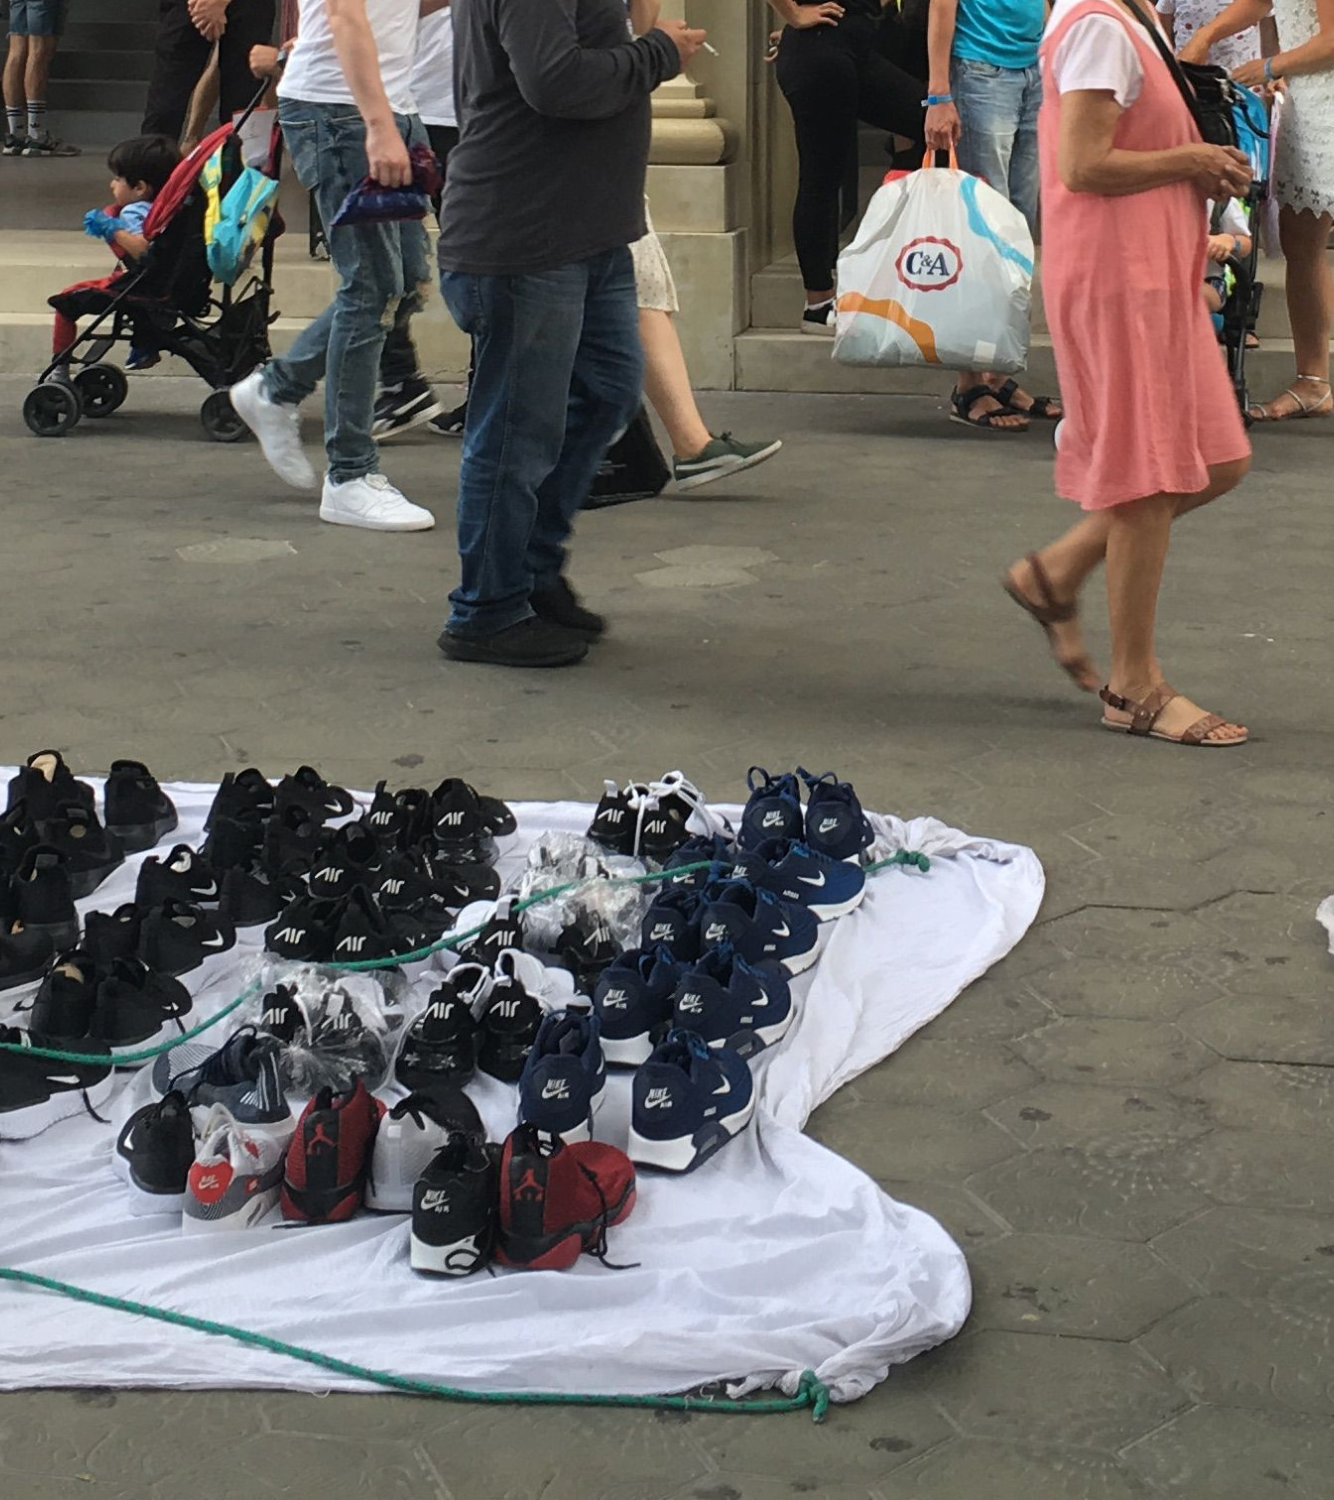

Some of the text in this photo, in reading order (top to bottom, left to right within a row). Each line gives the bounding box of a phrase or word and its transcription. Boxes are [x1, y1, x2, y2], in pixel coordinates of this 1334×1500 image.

[905, 250, 950, 276] C&A
[547, 1079, 567, 1089] NIKE
[649, 1088, 669, 1099] NIKE
